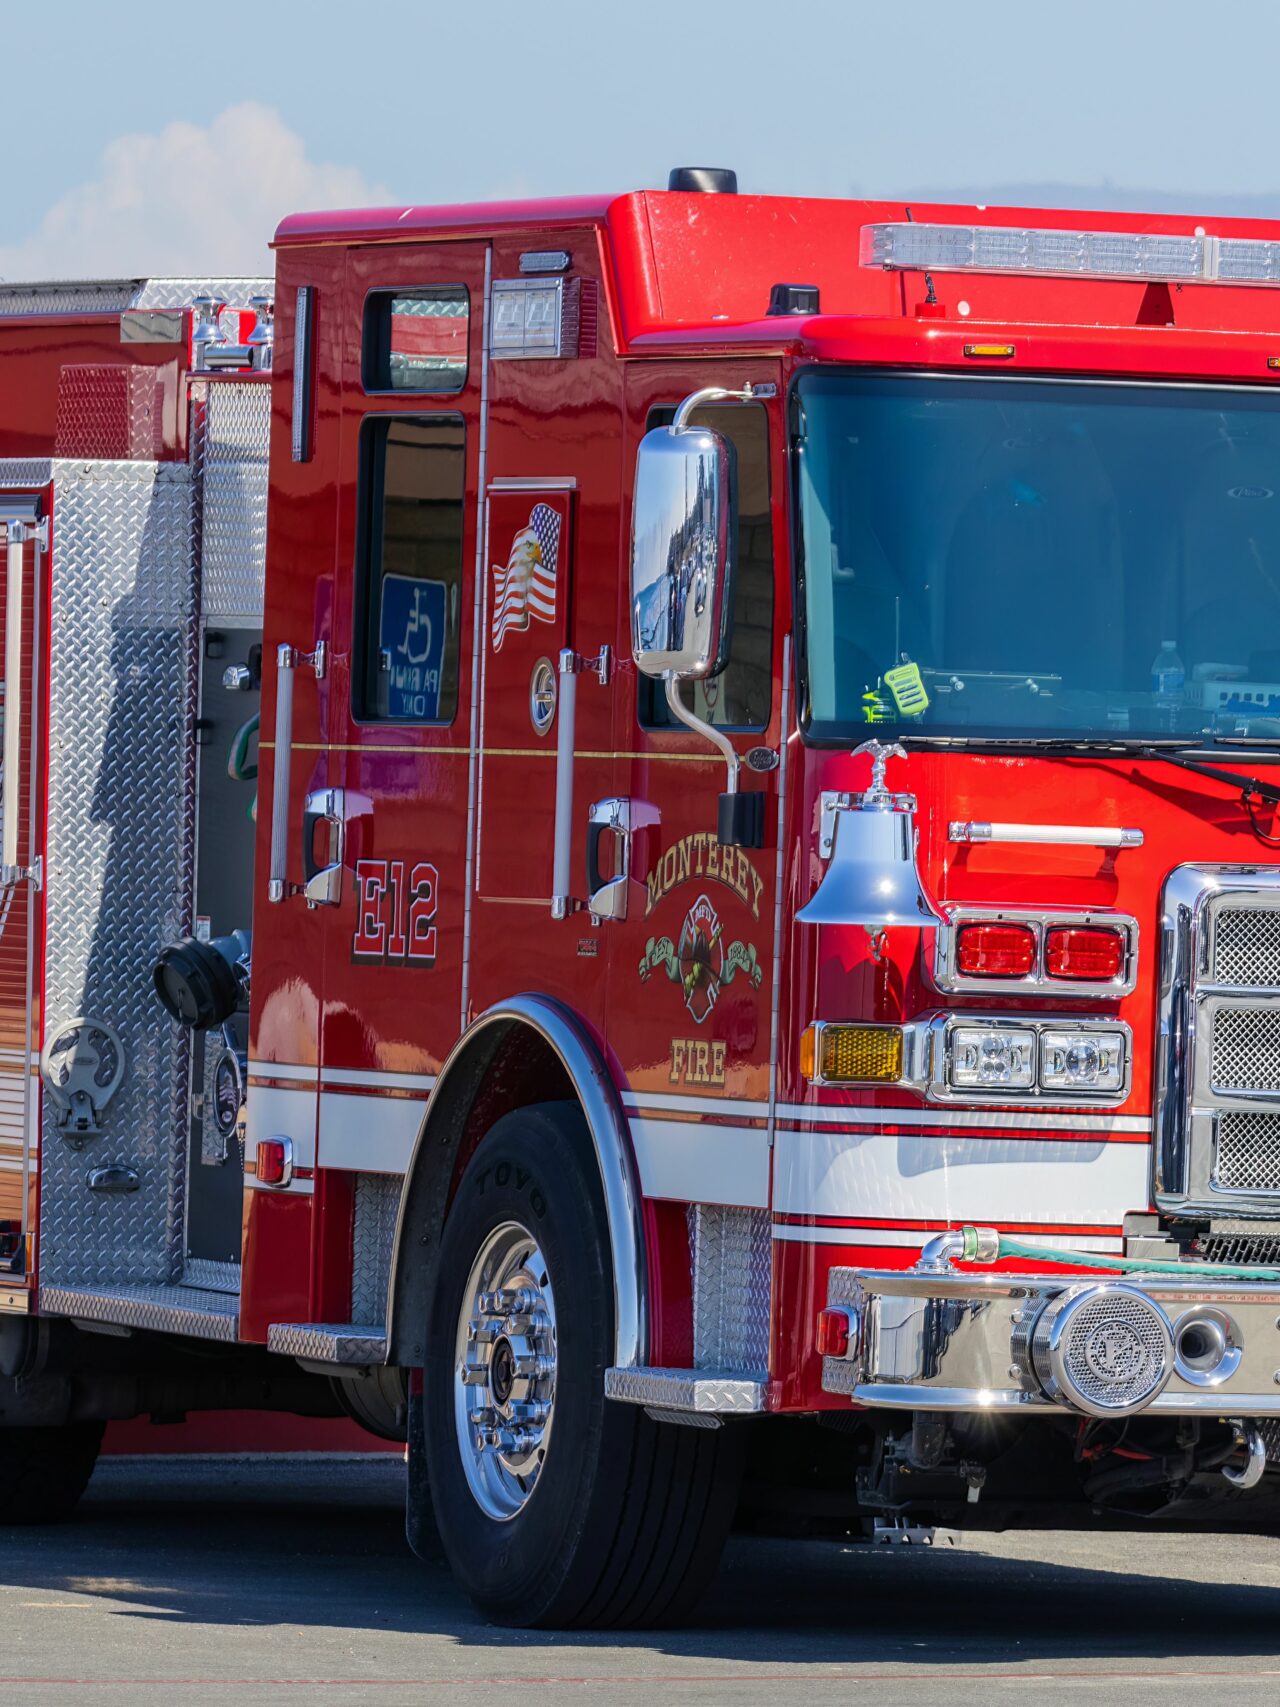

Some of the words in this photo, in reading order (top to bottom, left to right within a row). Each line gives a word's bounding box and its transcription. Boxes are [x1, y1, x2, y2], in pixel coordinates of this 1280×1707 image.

[645, 832, 764, 919] MONTEREY
[352, 859, 439, 963] E12
[695, 905, 711, 922] MFD
[670, 1039, 726, 1085] FIRE
[476, 1161, 546, 1220] TOYO
